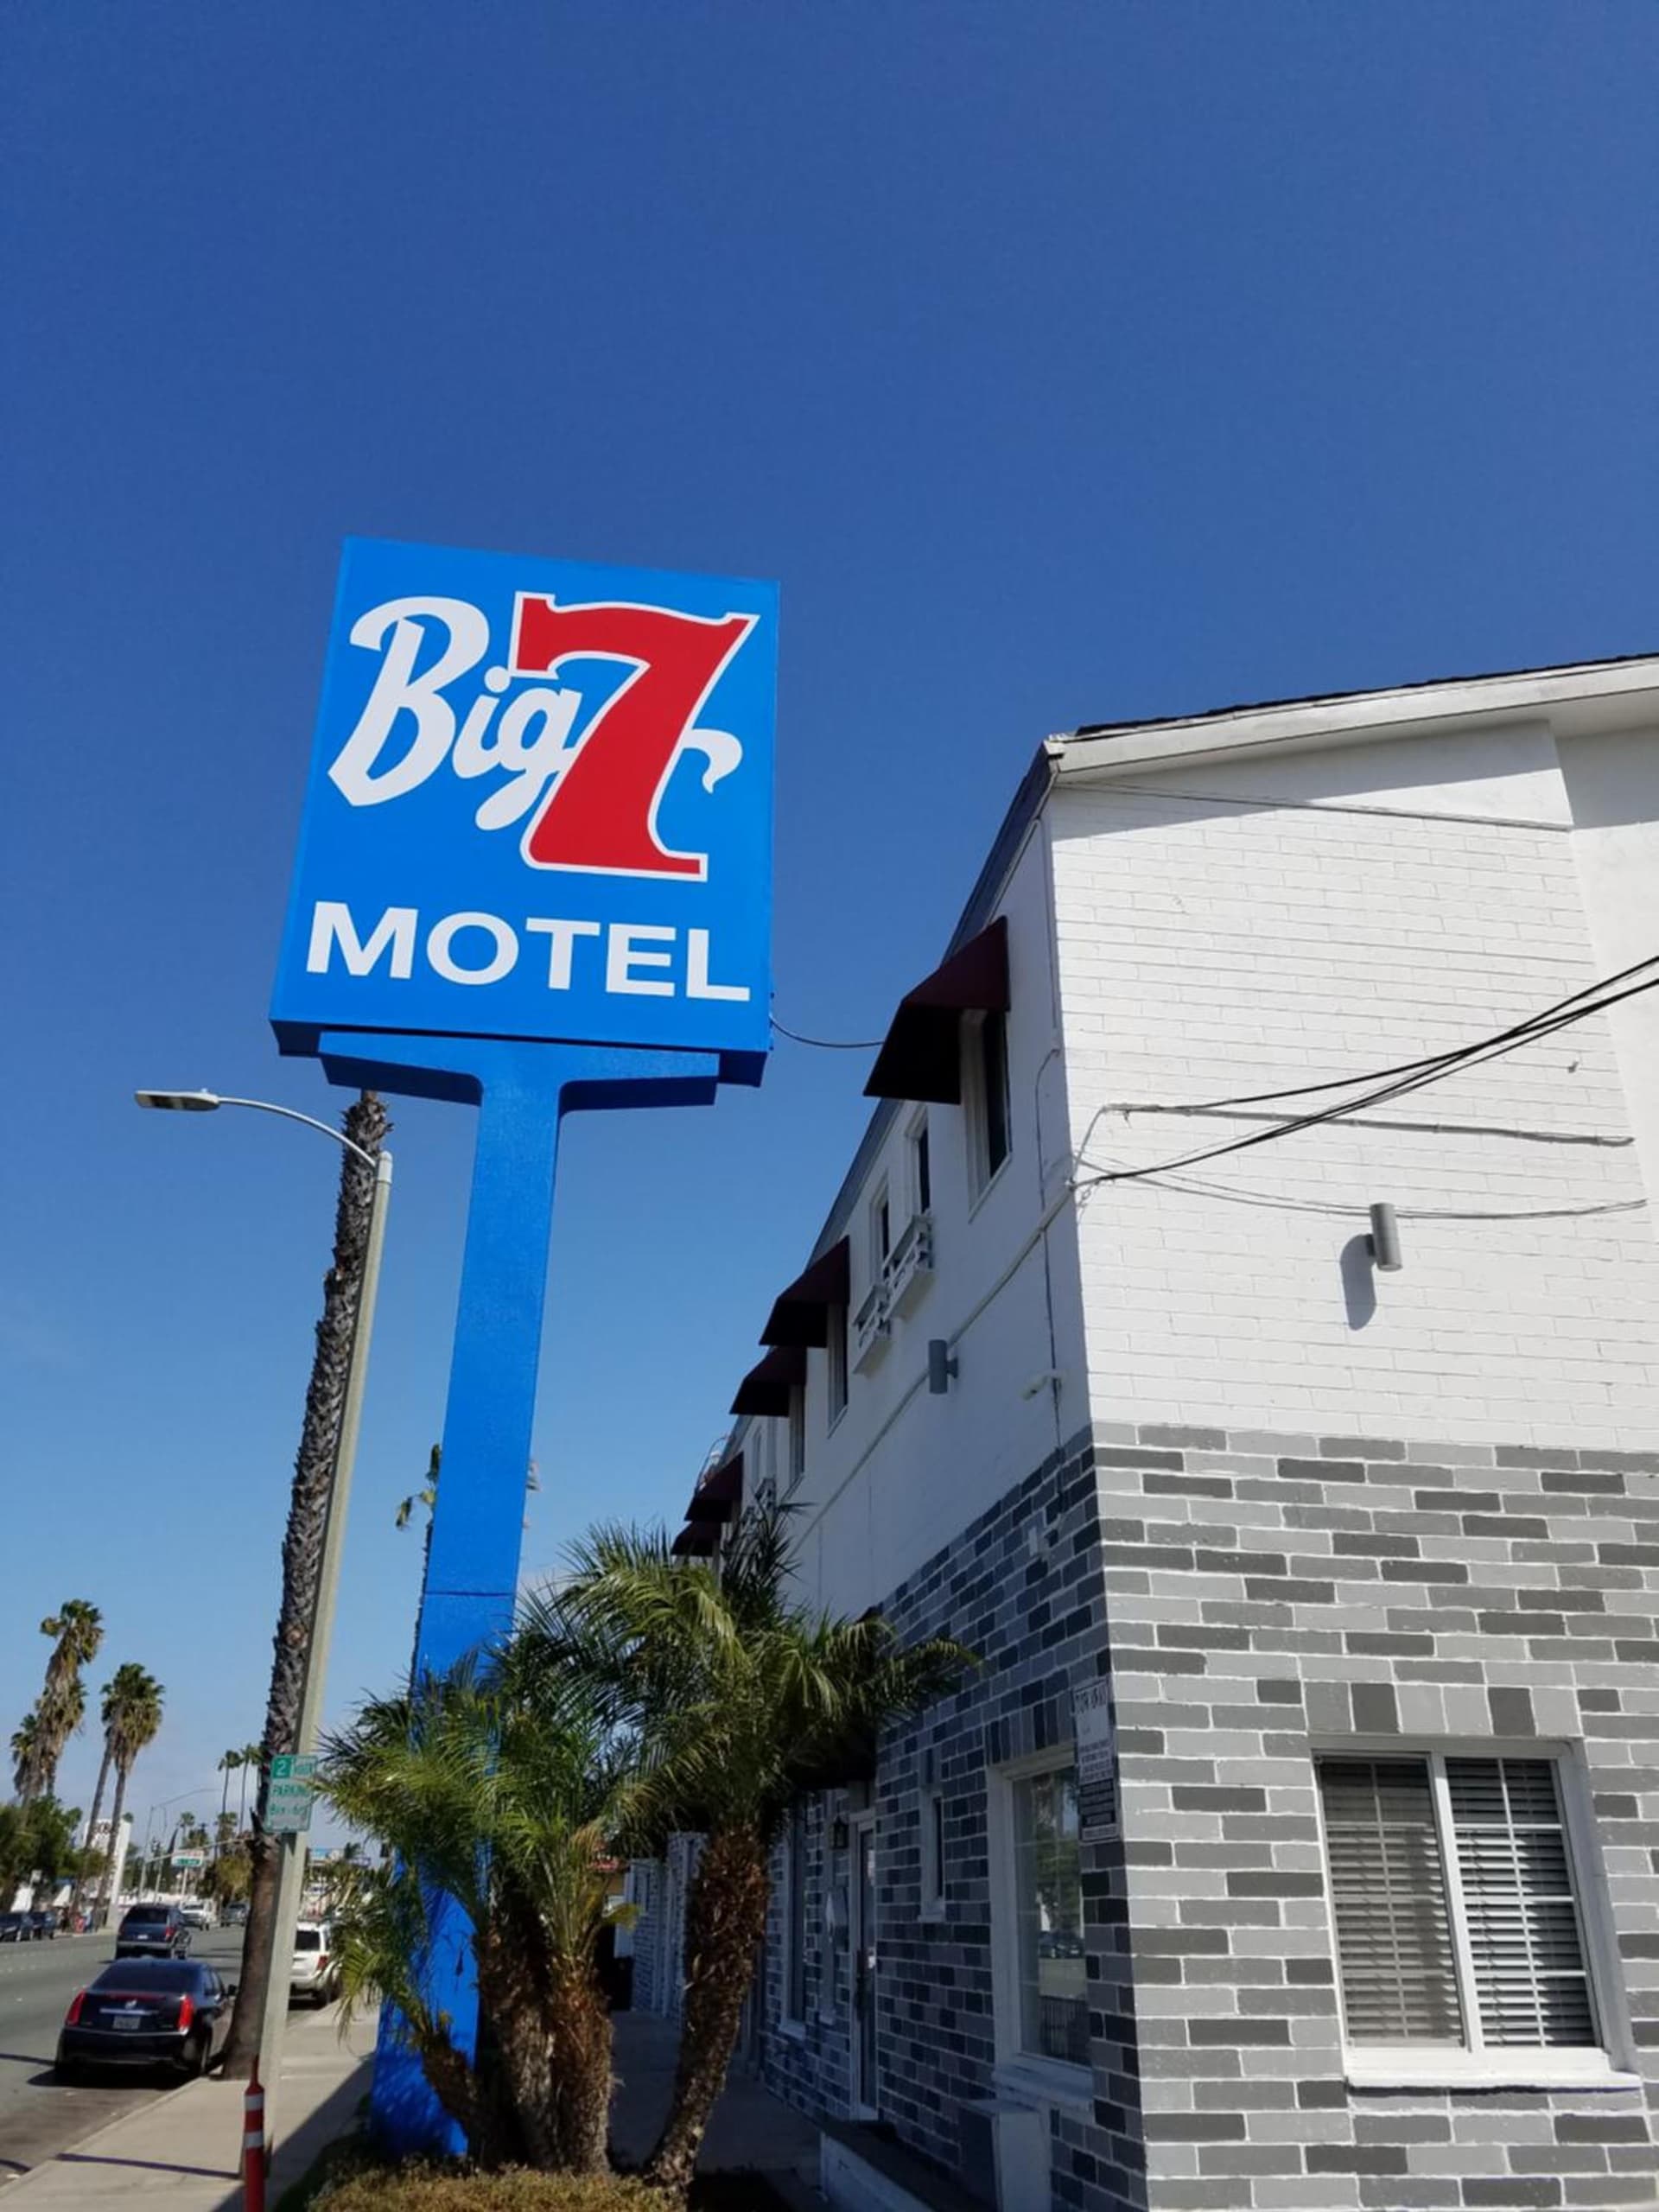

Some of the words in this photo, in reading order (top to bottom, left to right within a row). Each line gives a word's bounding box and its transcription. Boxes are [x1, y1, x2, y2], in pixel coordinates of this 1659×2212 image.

[328, 596, 583, 830] Big
[508, 591, 760, 881] 7
[307, 900, 751, 1001] MOTEL
[276, 1760, 287, 1777] 2
